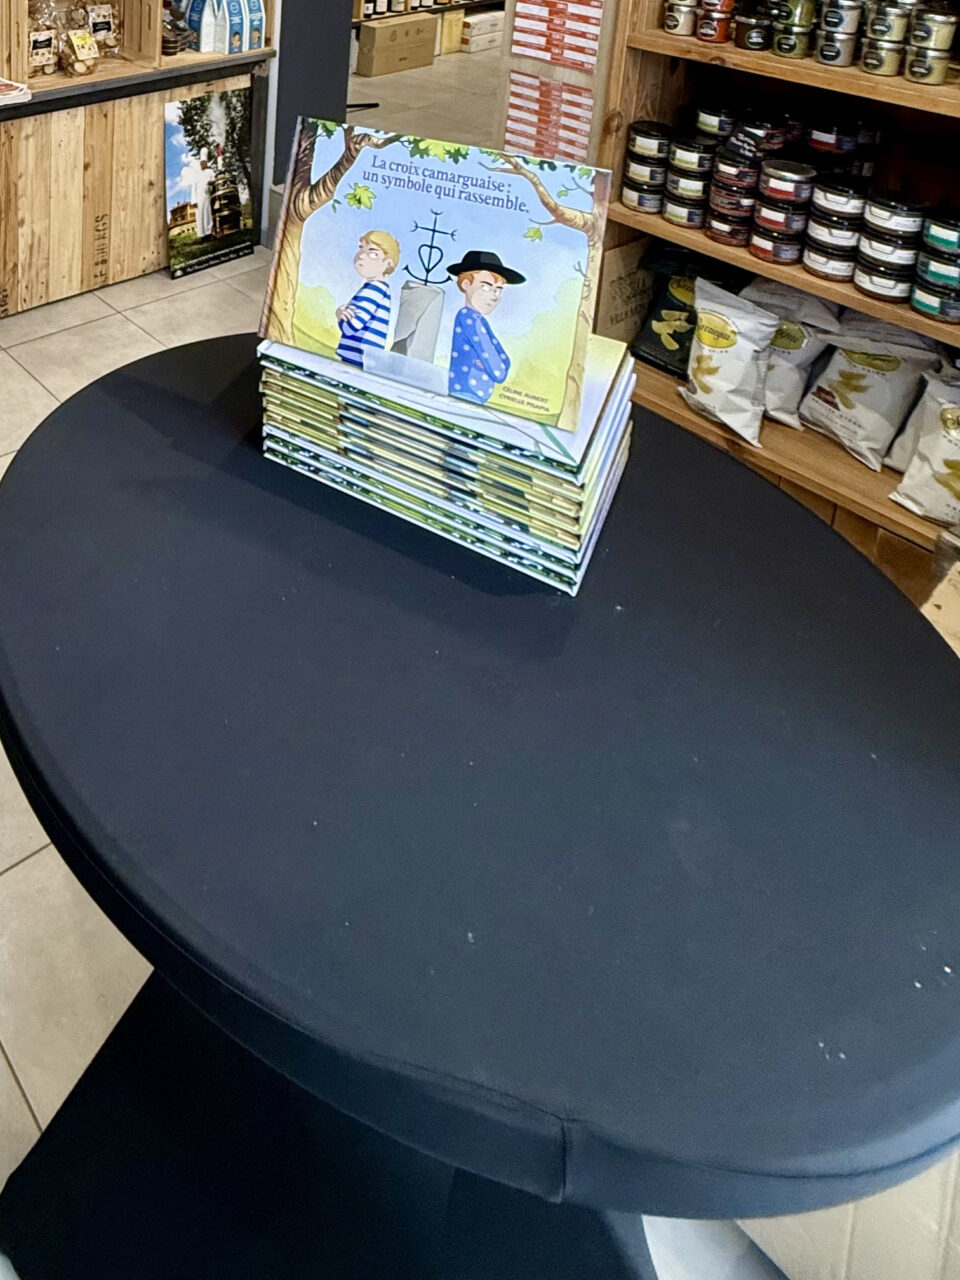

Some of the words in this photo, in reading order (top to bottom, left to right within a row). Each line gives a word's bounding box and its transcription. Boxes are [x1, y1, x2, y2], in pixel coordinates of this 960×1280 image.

[362, 170, 379, 183] un
[380, 173, 433, 194] symbole
[434, 183, 456, 200] qui
[457, 189, 530, 214] rassemble.
[371, 154, 387, 169] La
[390, 159, 420, 176] croix
[421, 166, 505, 193] camarguaise
